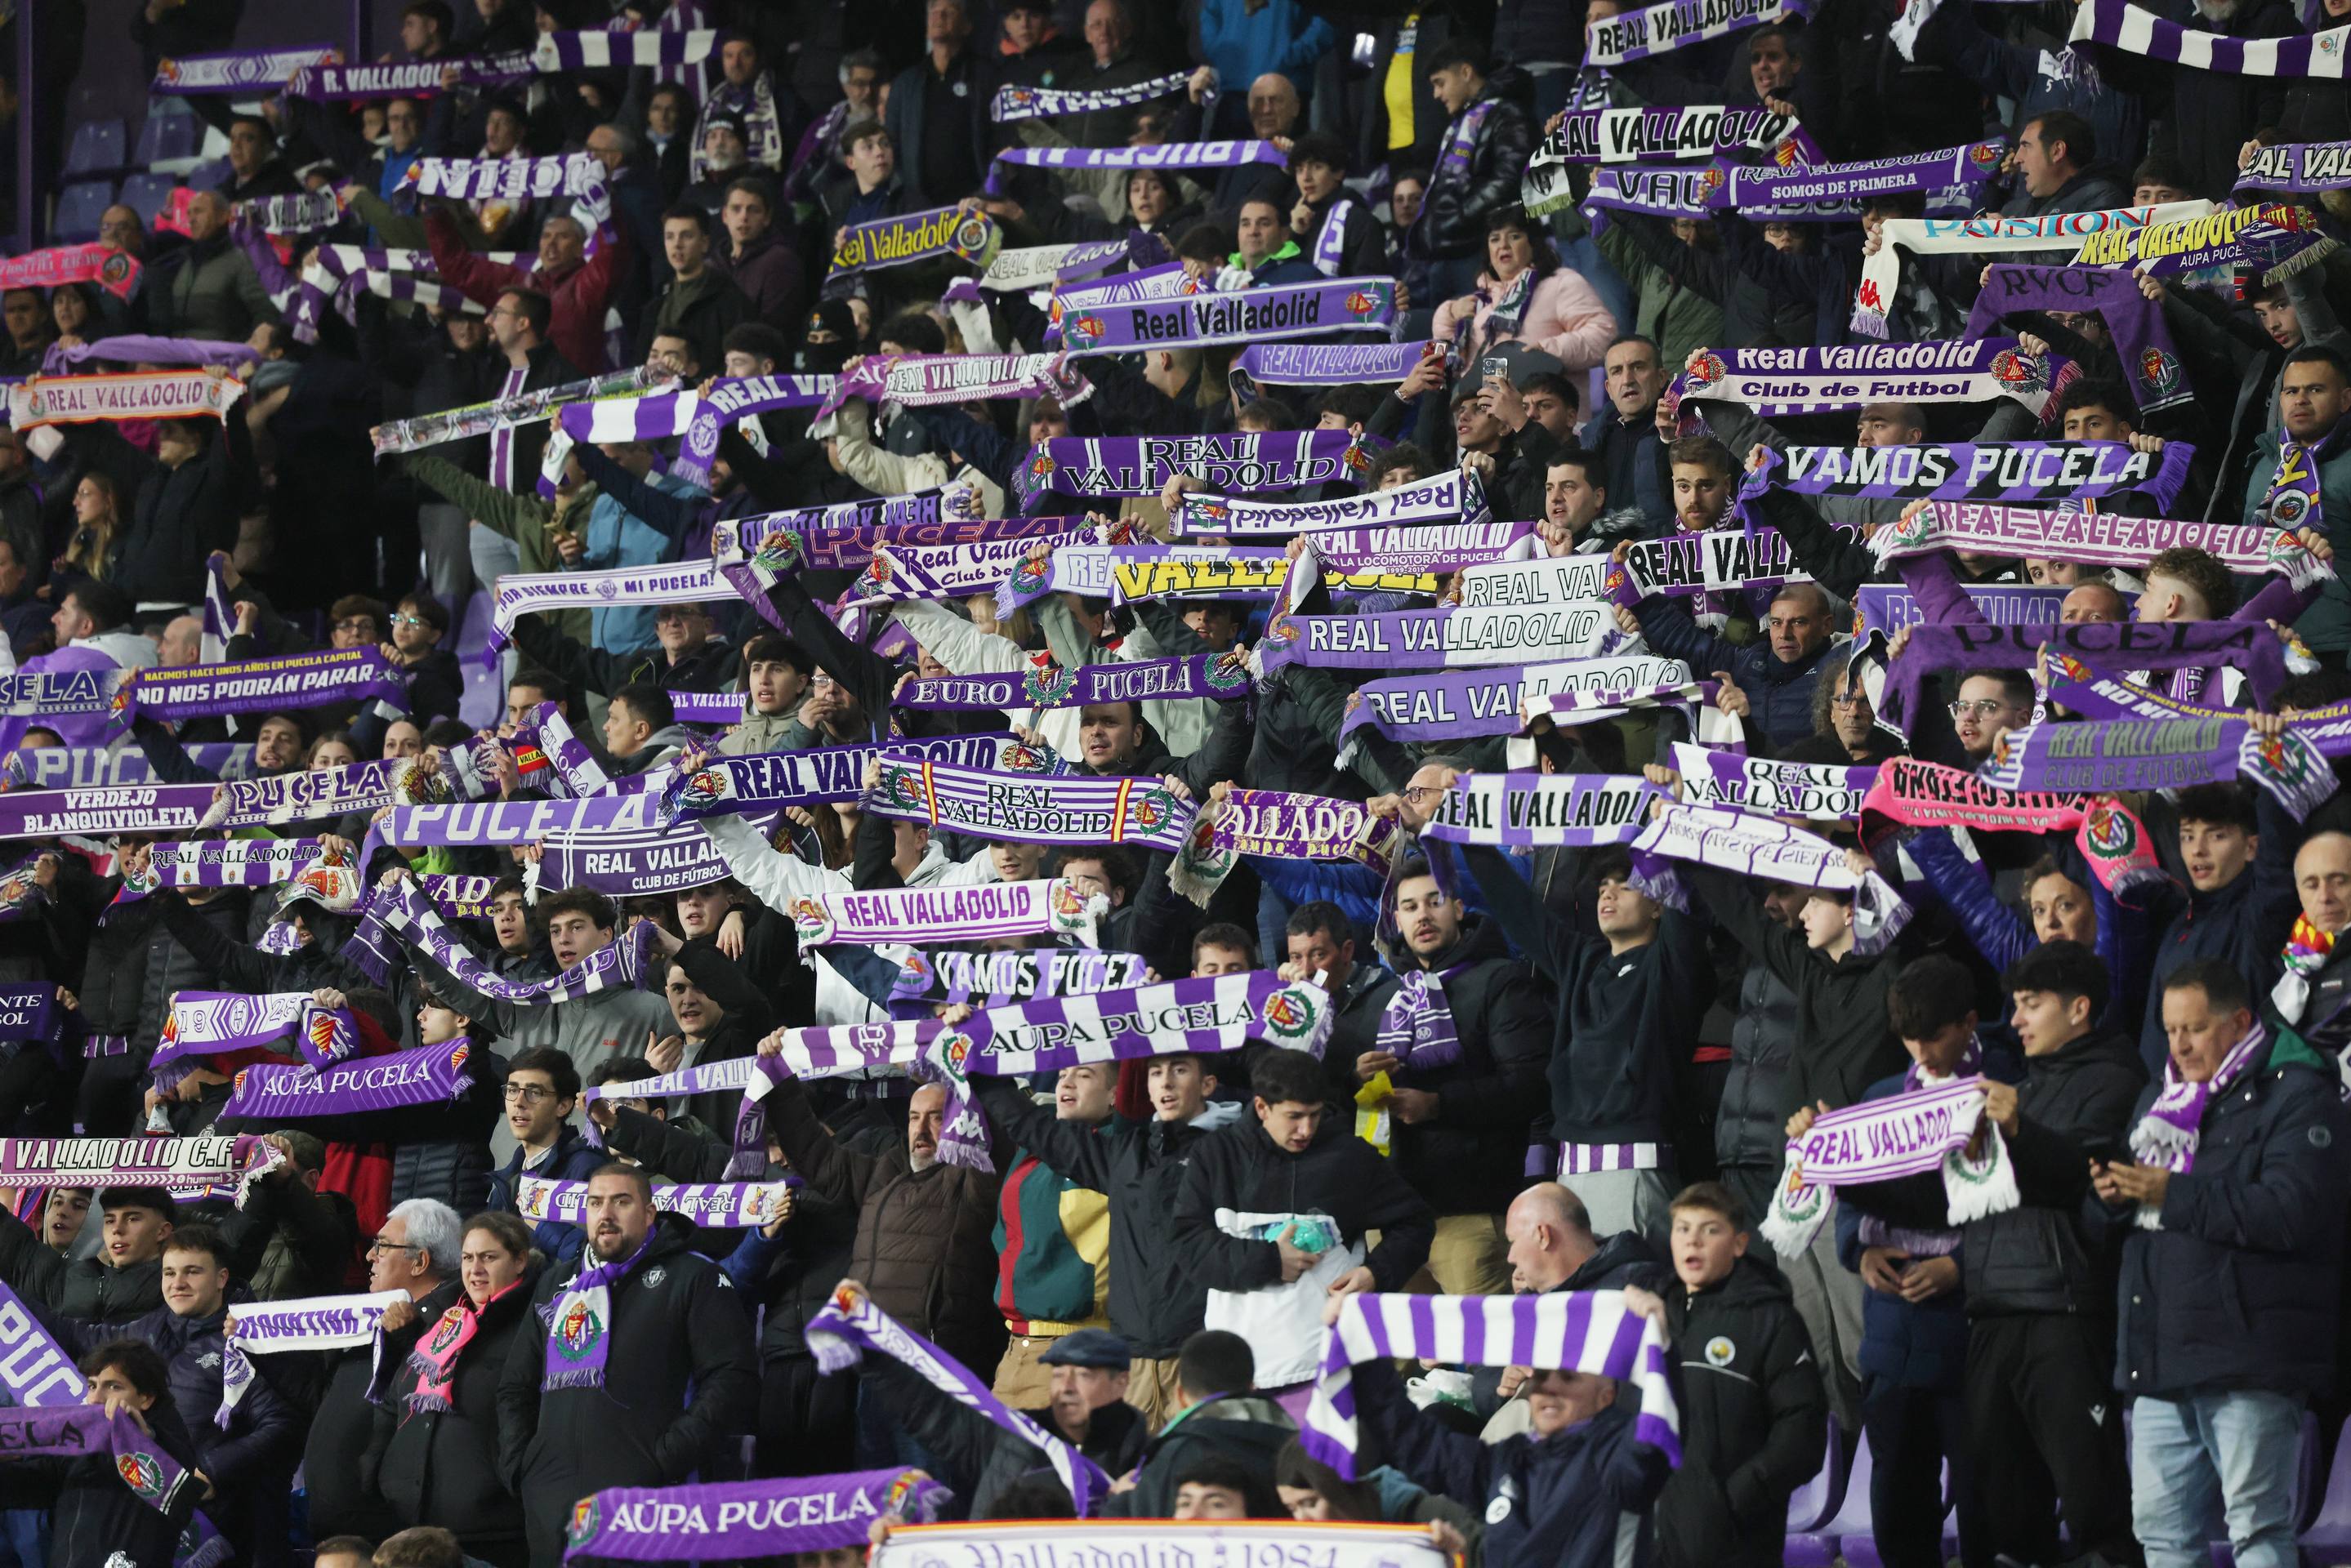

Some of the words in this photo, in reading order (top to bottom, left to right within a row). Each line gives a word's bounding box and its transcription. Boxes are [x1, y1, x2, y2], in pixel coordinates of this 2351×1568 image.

[1597, 20, 1648, 56] REAL
[346, 61, 463, 92] VALLADOL
[1609, 112, 1787, 154] VALLADOLID
[2300, 147, 2351, 178] VAL
[1772, 181, 1824, 199] SOMOS
[1827, 179, 1847, 194] DE
[1849, 173, 1918, 193] PRIMERA
[2179, 255, 2210, 268] AUPA
[2212, 245, 2245, 262] PUCE
[1132, 306, 1188, 341] Real
[1196, 292, 1321, 334] Valladolid
[1259, 344, 1303, 376] REAL
[1737, 346, 1813, 371] Real
[1818, 340, 1983, 370] Valladolid
[47, 387, 87, 412] REAL
[95, 381, 204, 408] VALLADOLID
[709, 376, 786, 412] REAL
[1740, 381, 1812, 398] Club
[1822, 381, 1862, 398] de
[1867, 380, 1972, 397] Futbol
[1144, 439, 1255, 467] REAL
[1784, 446, 1951, 487] VAMOS
[1965, 446, 2150, 488] PUCELA
[1063, 457, 1336, 493] VALLADOLID
[1234, 497, 1378, 529] Valladolid
[1391, 482, 1454, 517] Real
[1370, 523, 1514, 555] VALLADOLID
[1935, 502, 2015, 537] REAL
[2041, 510, 2271, 556] VALLADOLID
[901, 543, 958, 577] Real
[1068, 553, 1116, 587] REA
[1341, 556, 1355, 567] LA
[1357, 553, 1440, 567] LOCOMOTORA
[1443, 552, 1459, 563] DE
[1461, 550, 1505, 562] PUCELA
[1631, 538, 1705, 588] REAL
[1711, 531, 1802, 582] VALLA
[524, 582, 589, 598] SIEMPRE
[624, 578, 646, 593] MI
[649, 572, 716, 592] PUCELA!
[941, 570, 987, 586] Club
[1467, 570, 1552, 607] REAL
[1309, 619, 1390, 651] REAL
[1401, 610, 1599, 652] VALLADOLID
[144, 668, 187, 682] NACIMOS
[188, 666, 213, 679] HACE
[214, 664, 243, 677] UNOS
[243, 660, 270, 675] AÑOS
[271, 660, 285, 671] EN
[286, 656, 323, 670] PUCELA
[324, 650, 363, 665] CAPITAL
[136, 688, 165, 706] NO
[168, 681, 211, 702] NOS
[214, 669, 301, 697] PODRÁN
[304, 663, 374, 685] PARAR
[671, 694, 689, 708] AL
[692, 692, 747, 708] VALLADO
[912, 679, 1013, 704] EURO
[1090, 663, 1193, 702] PUCELA
[2090, 679, 2138, 706] NO
[2130, 700, 2180, 719] NO
[1369, 689, 1457, 725] REAL
[2048, 720, 2100, 759] REAL
[2102, 717, 2224, 759] VALLADOLID
[234, 764, 389, 815] PUCELA
[734, 760, 805, 800] REAL
[1750, 761, 1847, 789] REAL
[2043, 765, 2094, 790] CLUB
[2102, 764, 2128, 786] DE
[65, 789, 157, 809] VERDEJO
[987, 784, 1059, 811] REAL
[1508, 787, 1662, 830] VALLADOL
[24, 805, 199, 833] BLANQUIVIOLETA
[939, 797, 1112, 834] VALLADOLID
[151, 851, 195, 869] REAL
[201, 845, 323, 865] VALLADOLID
[586, 853, 636, 875] REAL
[648, 844, 720, 871] VALLAD
[632, 875, 667, 891] CLUB
[667, 873, 683, 888] DE
[685, 865, 724, 886] FÚTBOL
[846, 894, 899, 927] REAL
[902, 885, 1032, 925] VALLADOLID
[935, 952, 1038, 995] VAMOS
[1100, 1000, 1257, 1041] PUCELA
[328, 1059, 432, 1095] PUCELA
[632, 1071, 689, 1097] REAL
[1803, 1127, 1865, 1165] REAL
[1867, 1098, 1970, 1159] VALLADO
[16, 1138, 182, 1170] VALLADOLID
[188, 1138, 243, 1168] C.F.
[185, 1174, 224, 1183] hummel
[684, 1192, 738, 1214] REAL
[716, 1487, 877, 1533] PUCELA
